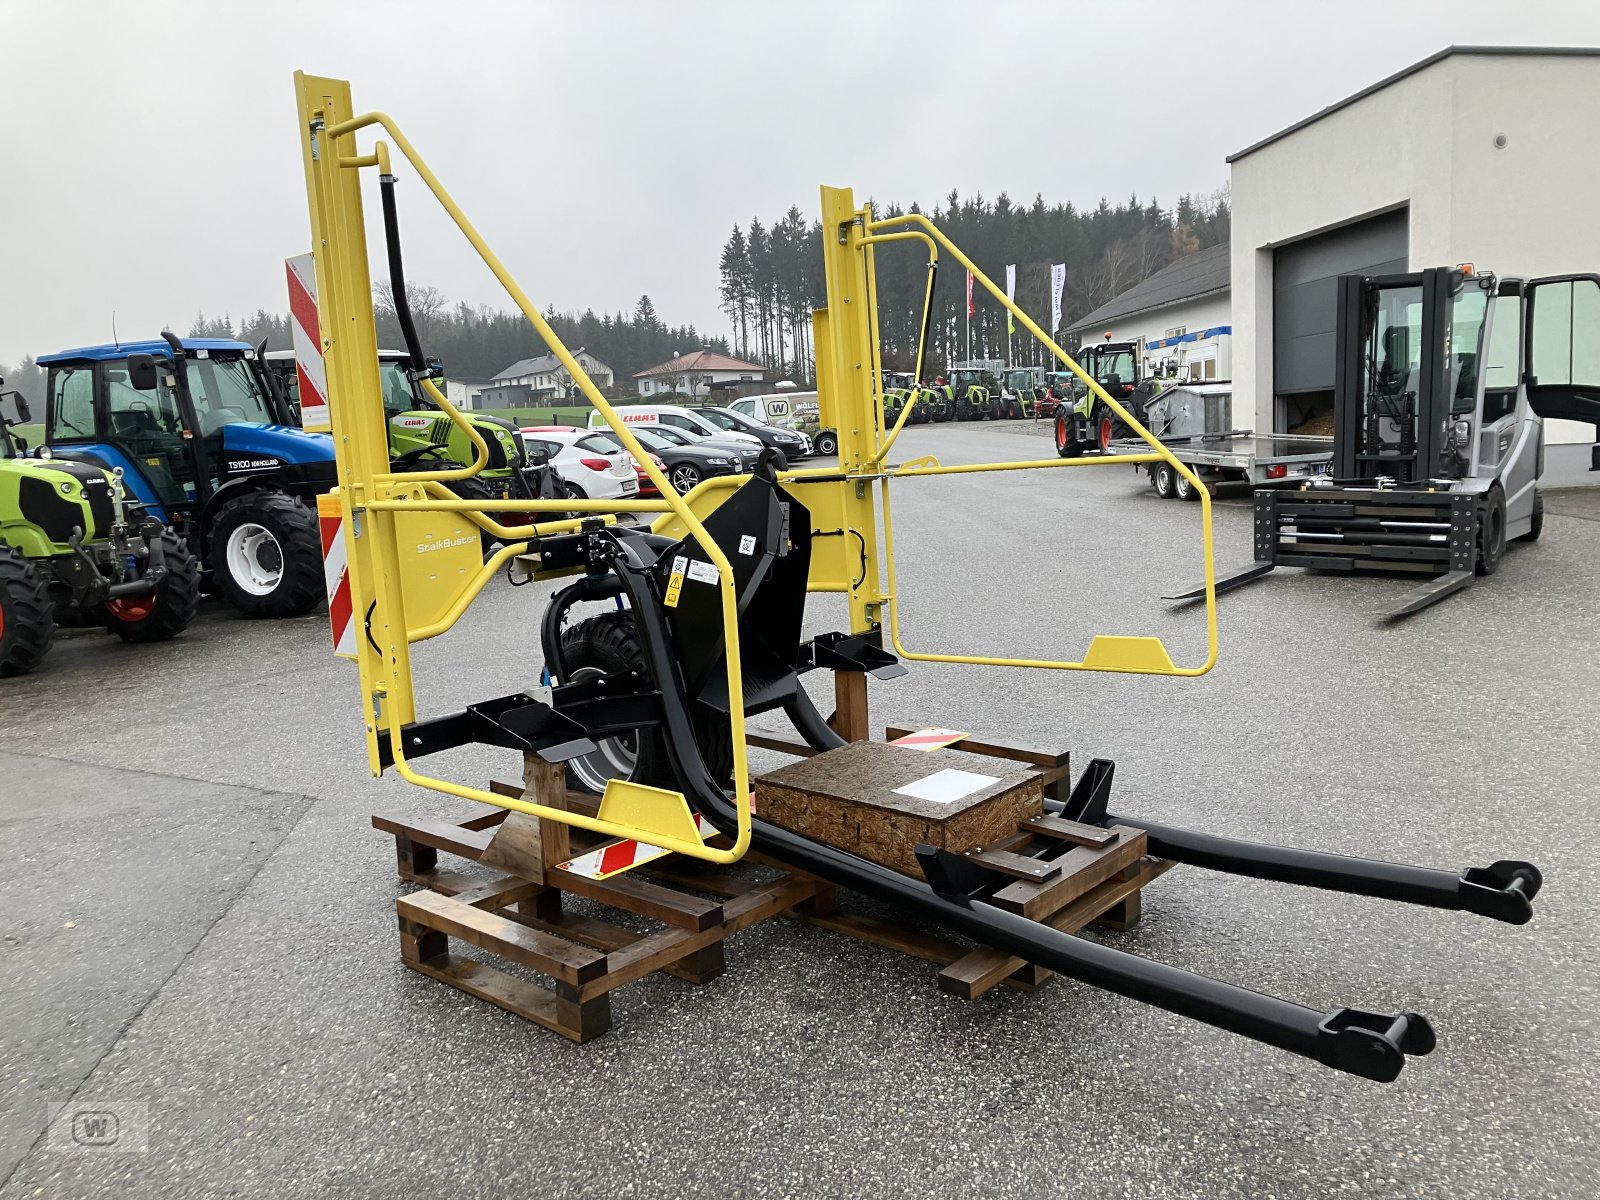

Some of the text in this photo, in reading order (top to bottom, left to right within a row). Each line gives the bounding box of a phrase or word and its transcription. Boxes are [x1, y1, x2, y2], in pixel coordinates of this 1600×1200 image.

[772, 403, 785, 414] W
[796, 402, 819, 410] WÖLFL
[623, 414, 656, 423] CLAAS
[228, 460, 250, 469] TS100
[417, 535, 477, 554] StalkBuster
